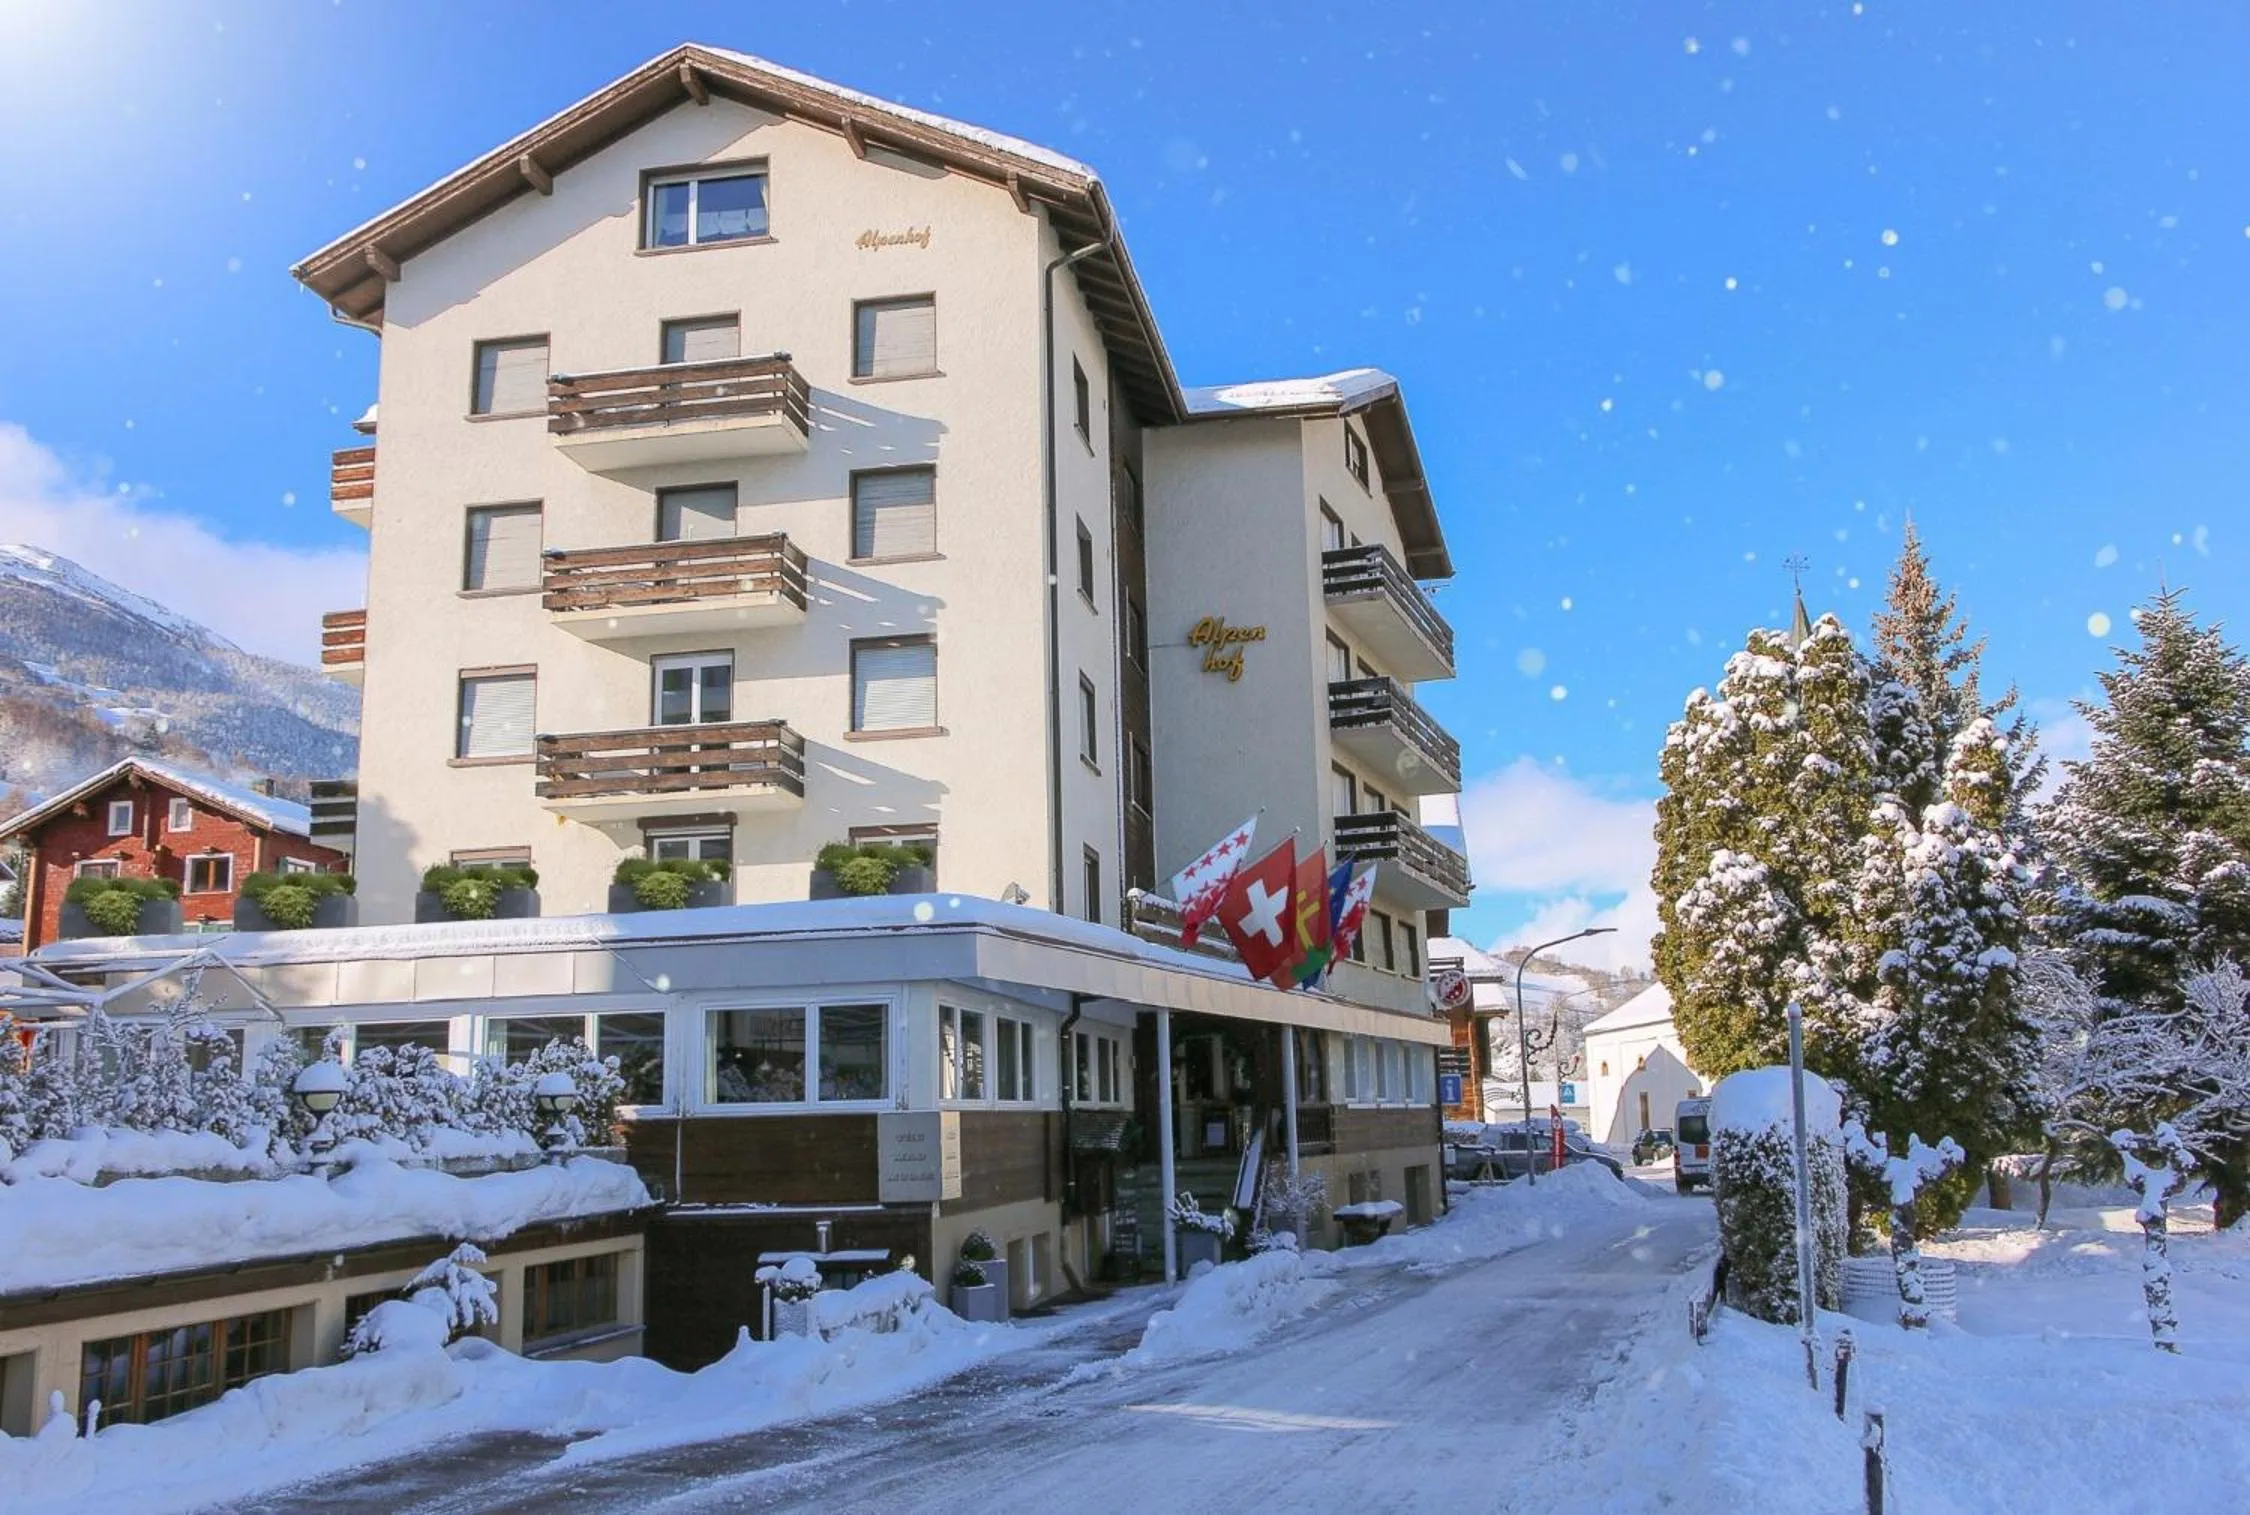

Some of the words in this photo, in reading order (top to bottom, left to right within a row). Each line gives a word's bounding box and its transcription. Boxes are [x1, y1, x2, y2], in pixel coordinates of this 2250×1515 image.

[855, 224, 931, 252] Alpenhof
[1188, 616, 1266, 651] Alpen
[1203, 646, 1244, 681] hof
